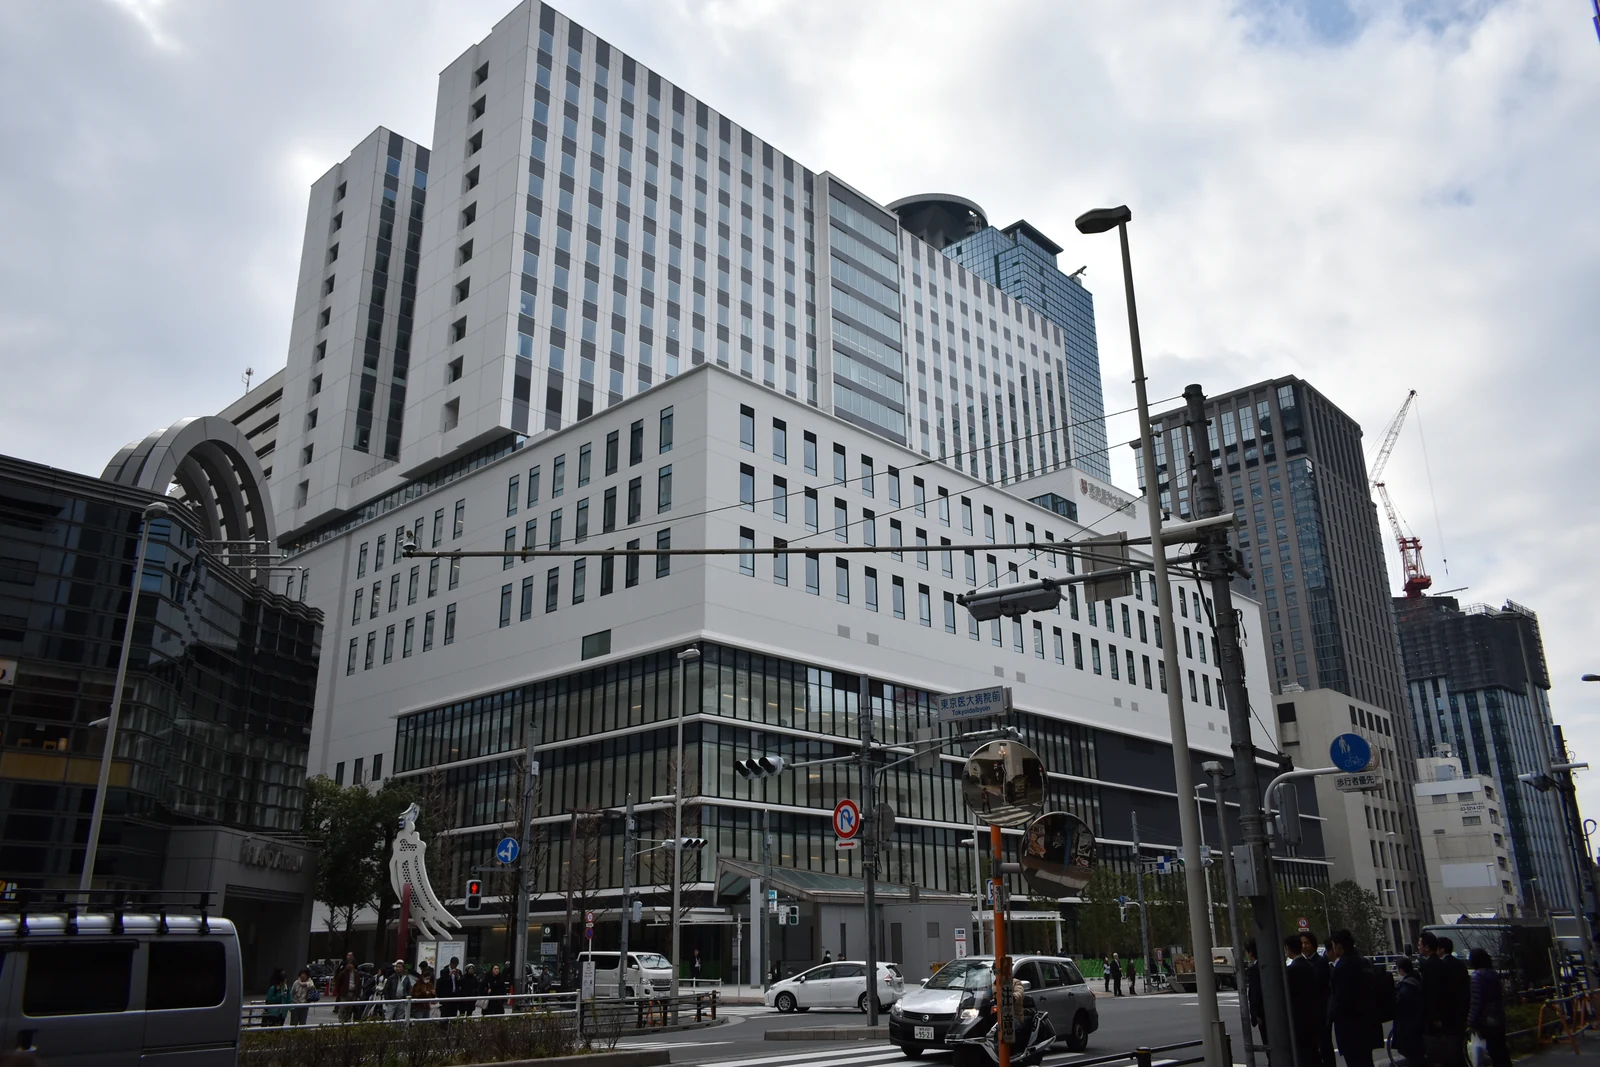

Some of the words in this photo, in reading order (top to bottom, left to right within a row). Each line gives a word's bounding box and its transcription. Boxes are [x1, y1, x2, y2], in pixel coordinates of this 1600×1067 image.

[941, 691, 1000, 710] 東京医大病院前
[952, 705, 991, 716] Tokyoidaibyoin
[1336, 775, 1375, 787] 歩行者優先
[1002, 987, 1014, 1036] 注意
